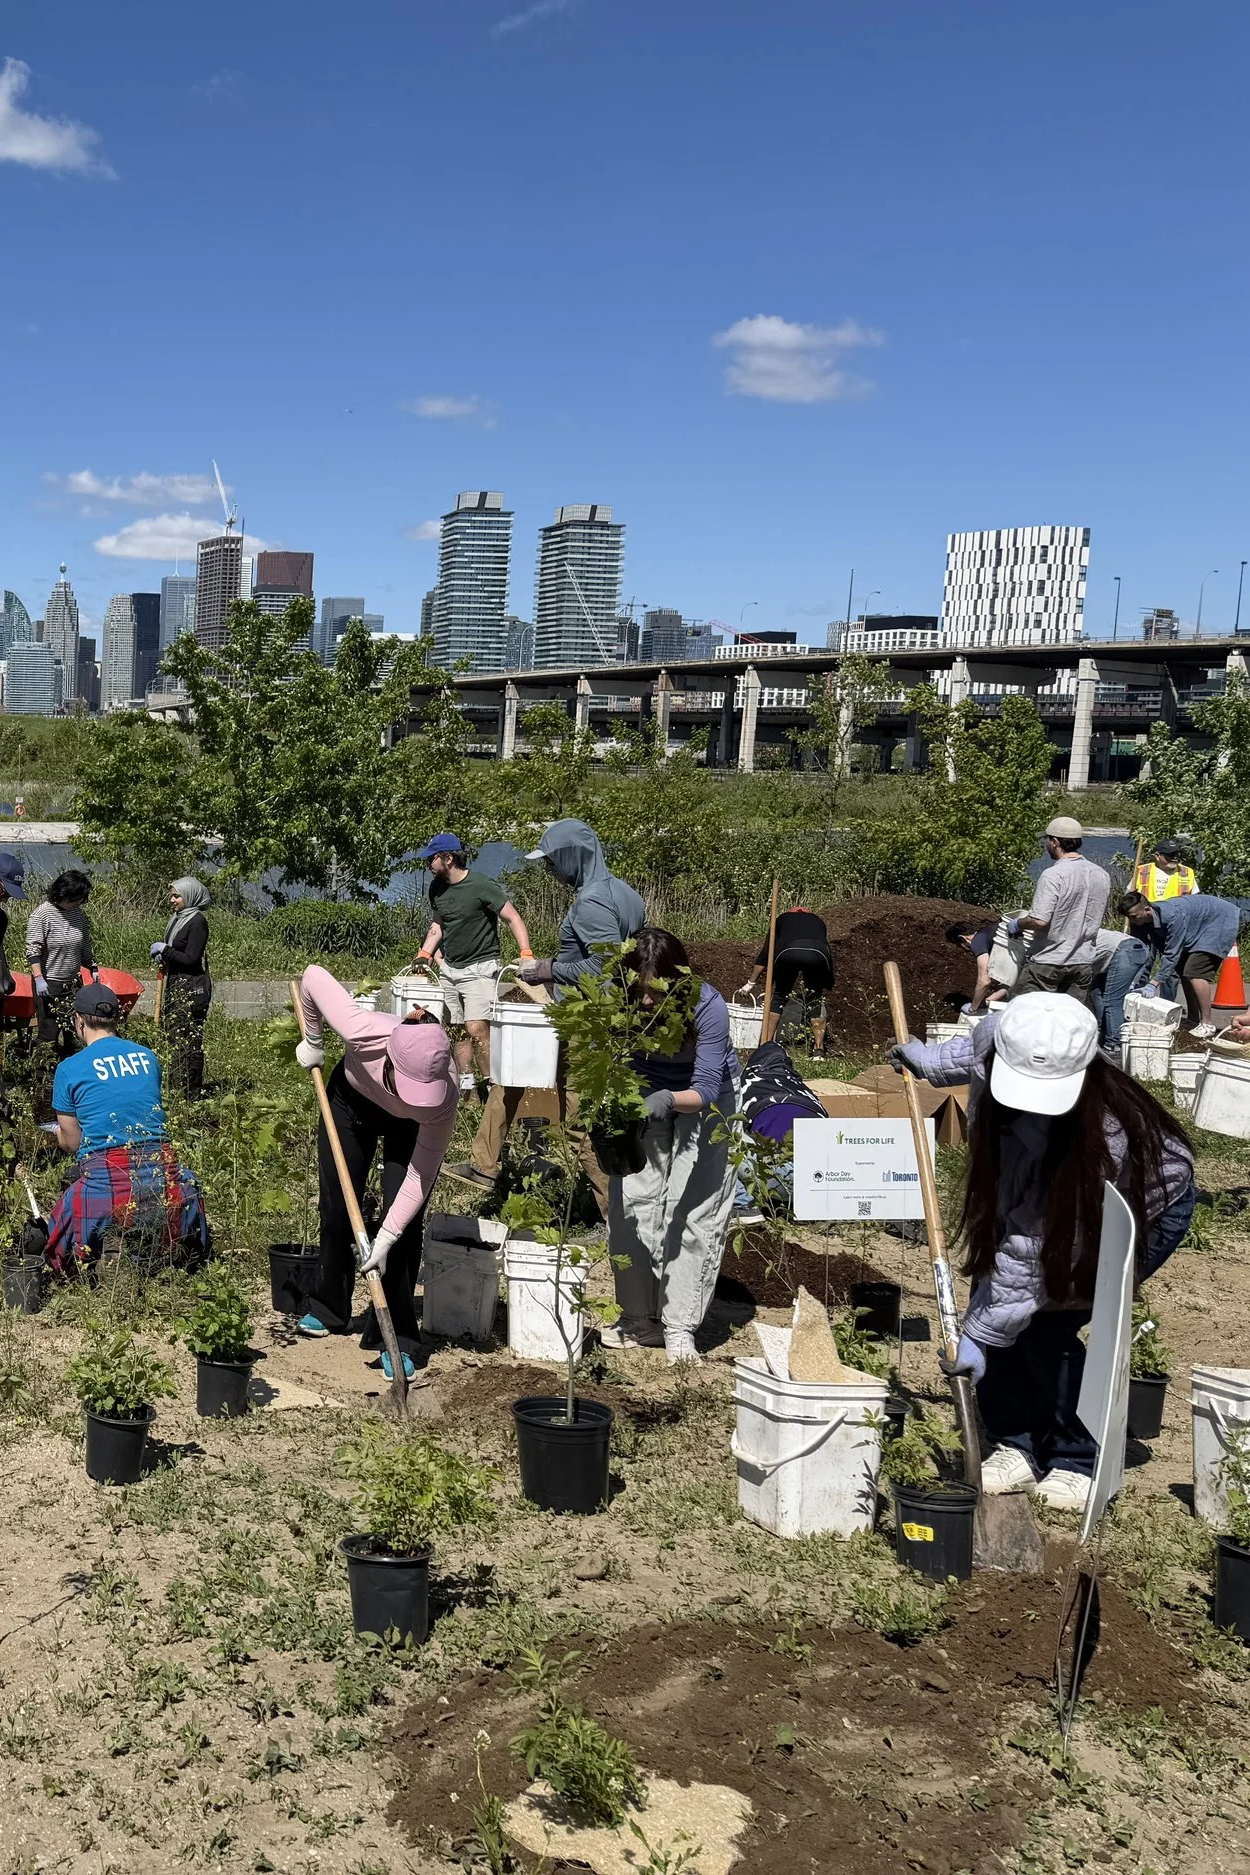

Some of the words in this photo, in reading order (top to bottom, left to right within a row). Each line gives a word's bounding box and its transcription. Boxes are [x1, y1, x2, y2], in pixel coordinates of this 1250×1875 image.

[93, 1052, 150, 1081] STAFF
[844, 1137, 865, 1145] TREES
[866, 1137, 880, 1145] FOR
[881, 1137, 895, 1145] LIFE
[892, 1171, 918, 1182] TORONTO
